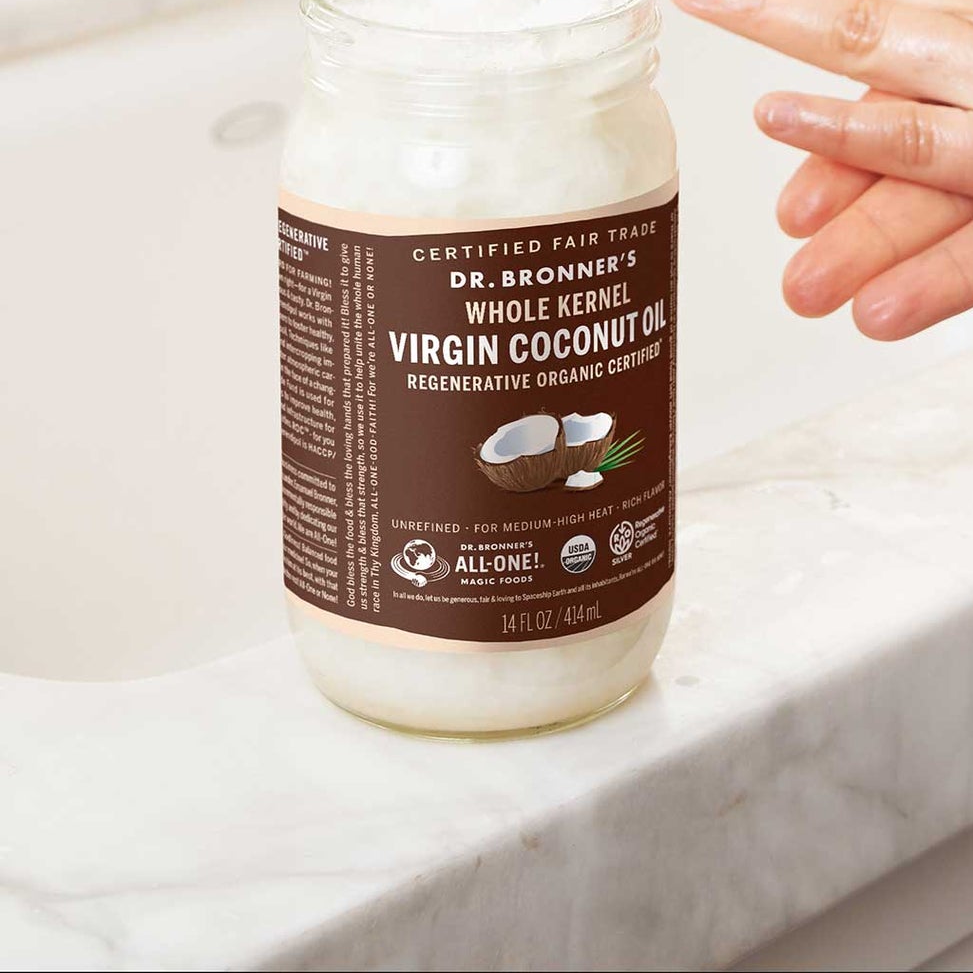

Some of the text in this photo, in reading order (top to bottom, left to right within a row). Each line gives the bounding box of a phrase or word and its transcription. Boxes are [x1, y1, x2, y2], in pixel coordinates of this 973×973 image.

[412, 221, 656, 261] CERTIFIED FAIR TRADE
[340, 243, 350, 264] give
[352, 245, 361, 279] human
[366, 246, 374, 280] NONE!
[297, 268, 331, 288] FARMING!
[340, 267, 348, 276] to
[450, 250, 637, 289] DR. BRONNER'S
[340, 289, 349, 315] Bless
[353, 281, 362, 310] whole
[367, 285, 375, 299] OR
[465, 282, 631, 324] WHOLE KERNEL
[341, 318, 350, 329] it!
[353, 313, 362, 329] the
[388, 298, 666, 365] VIRGIN COCONUT OIL
[342, 331, 352, 376] prepared
[354, 331, 363, 356] unite
[354, 358, 365, 379] help
[366, 351, 376, 378] we're
[408, 374, 530, 391] REGENERATIVE
[537, 363, 603, 387] ORGANIC
[342, 378, 351, 398] that
[356, 383, 363, 392] to
[367, 381, 376, 396] For
[355, 394, 364, 402] it
[343, 401, 352, 430] hands
[356, 404, 364, 421] use
[357, 423, 364, 436] we
[343, 433, 354, 461] loving
[357, 439, 365, 450] so
[344, 464, 353, 479] the
[344, 482, 354, 507] bless
[345, 509, 353, 517] &
[357, 498, 366, 517] that
[392, 519, 460, 533] UNREFINED
[474, 523, 498, 533] FOR
[503, 513, 584, 532] MEDIUM-HIGH
[588, 505, 614, 520] HEAT
[622, 495, 641, 509] RICH
[345, 519, 354, 541] food
[358, 520, 366, 544] bless
[346, 543, 354, 558] the
[460, 541, 533, 551] DR. BRONNER'S
[568, 543, 589, 554] USDA
[371, 559, 381, 577] Thy
[565, 554, 592, 565] ORGANIC
[612, 553, 632, 566] SILVER
[346, 561, 355, 585] bless
[358, 556, 369, 596] strength
[460, 575, 533, 585] MAGIC FOODS
[371, 580, 380, 589] in
[346, 588, 355, 607] God
[360, 599, 368, 610] us
[372, 592, 380, 613] race
[502, 600, 602, 633] 14 FL OZ / 414 mL
